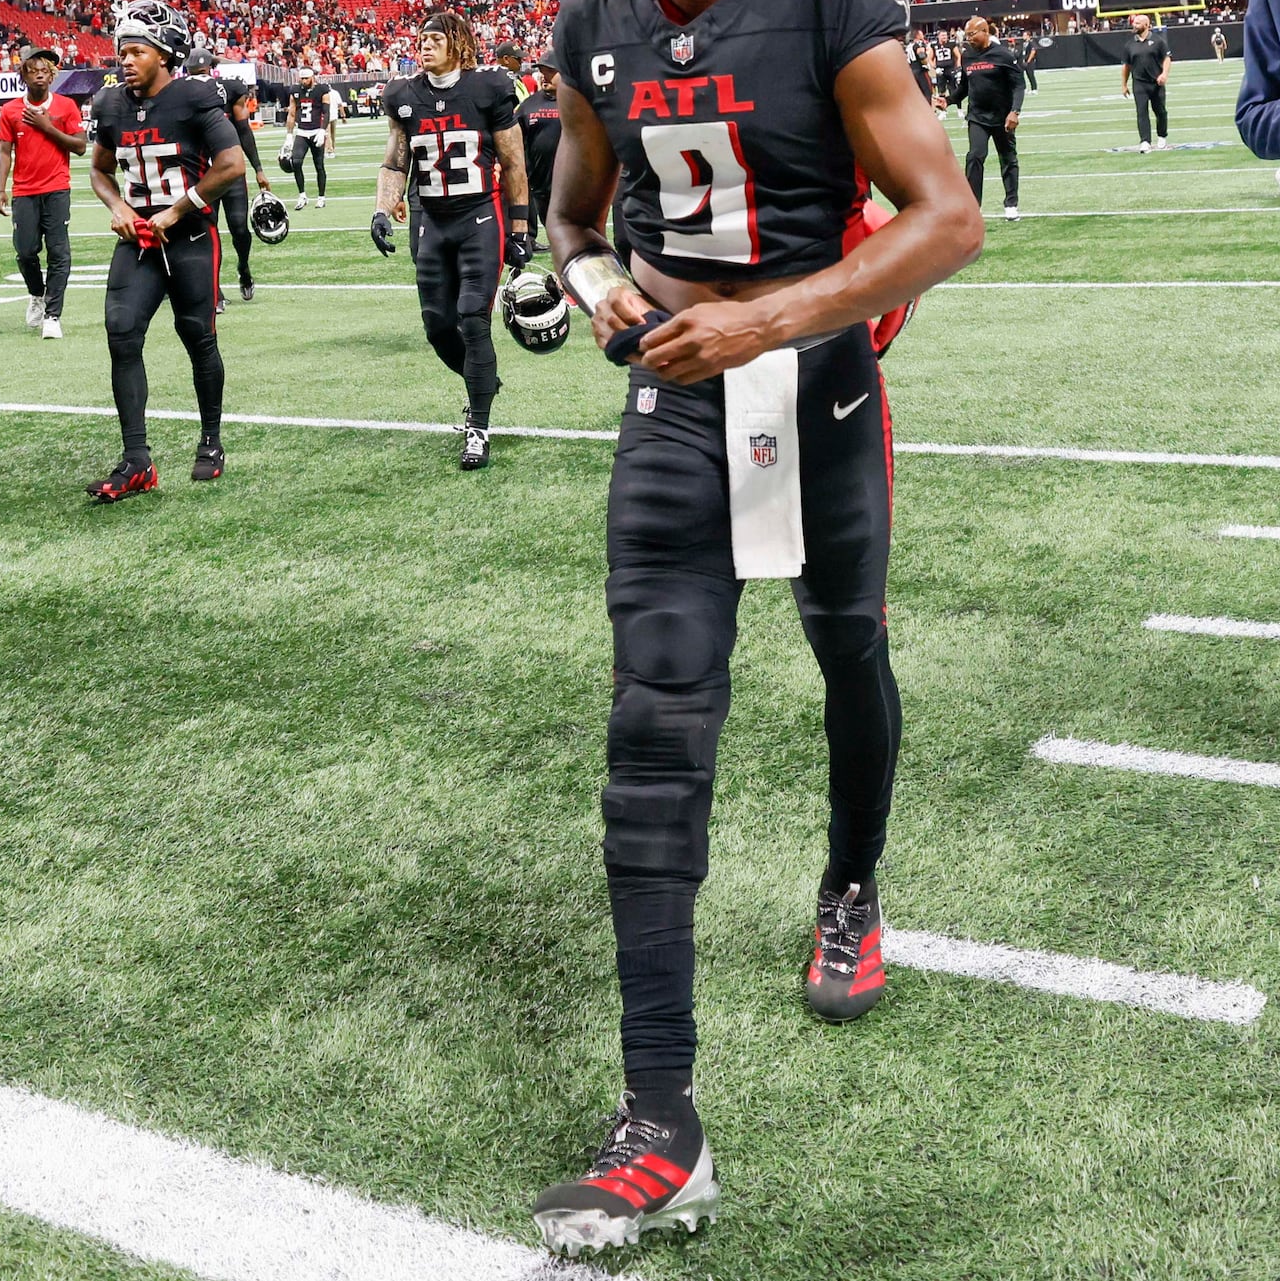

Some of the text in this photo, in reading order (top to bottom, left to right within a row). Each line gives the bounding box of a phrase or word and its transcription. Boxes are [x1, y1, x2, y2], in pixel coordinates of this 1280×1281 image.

[675, 48, 691, 58] NFL
[935, 48, 951, 61] 63
[591, 53, 614, 86] C
[104, 74, 118, 87] 25
[628, 74, 754, 120] ATL
[300, 103, 312, 122] 3
[419, 114, 466, 133] ATL
[121, 127, 165, 146] ATL
[410, 130, 485, 197] 33
[641, 121, 761, 265] 9
[640, 400, 654, 409] NFL
[753, 448, 774, 463] NFL
